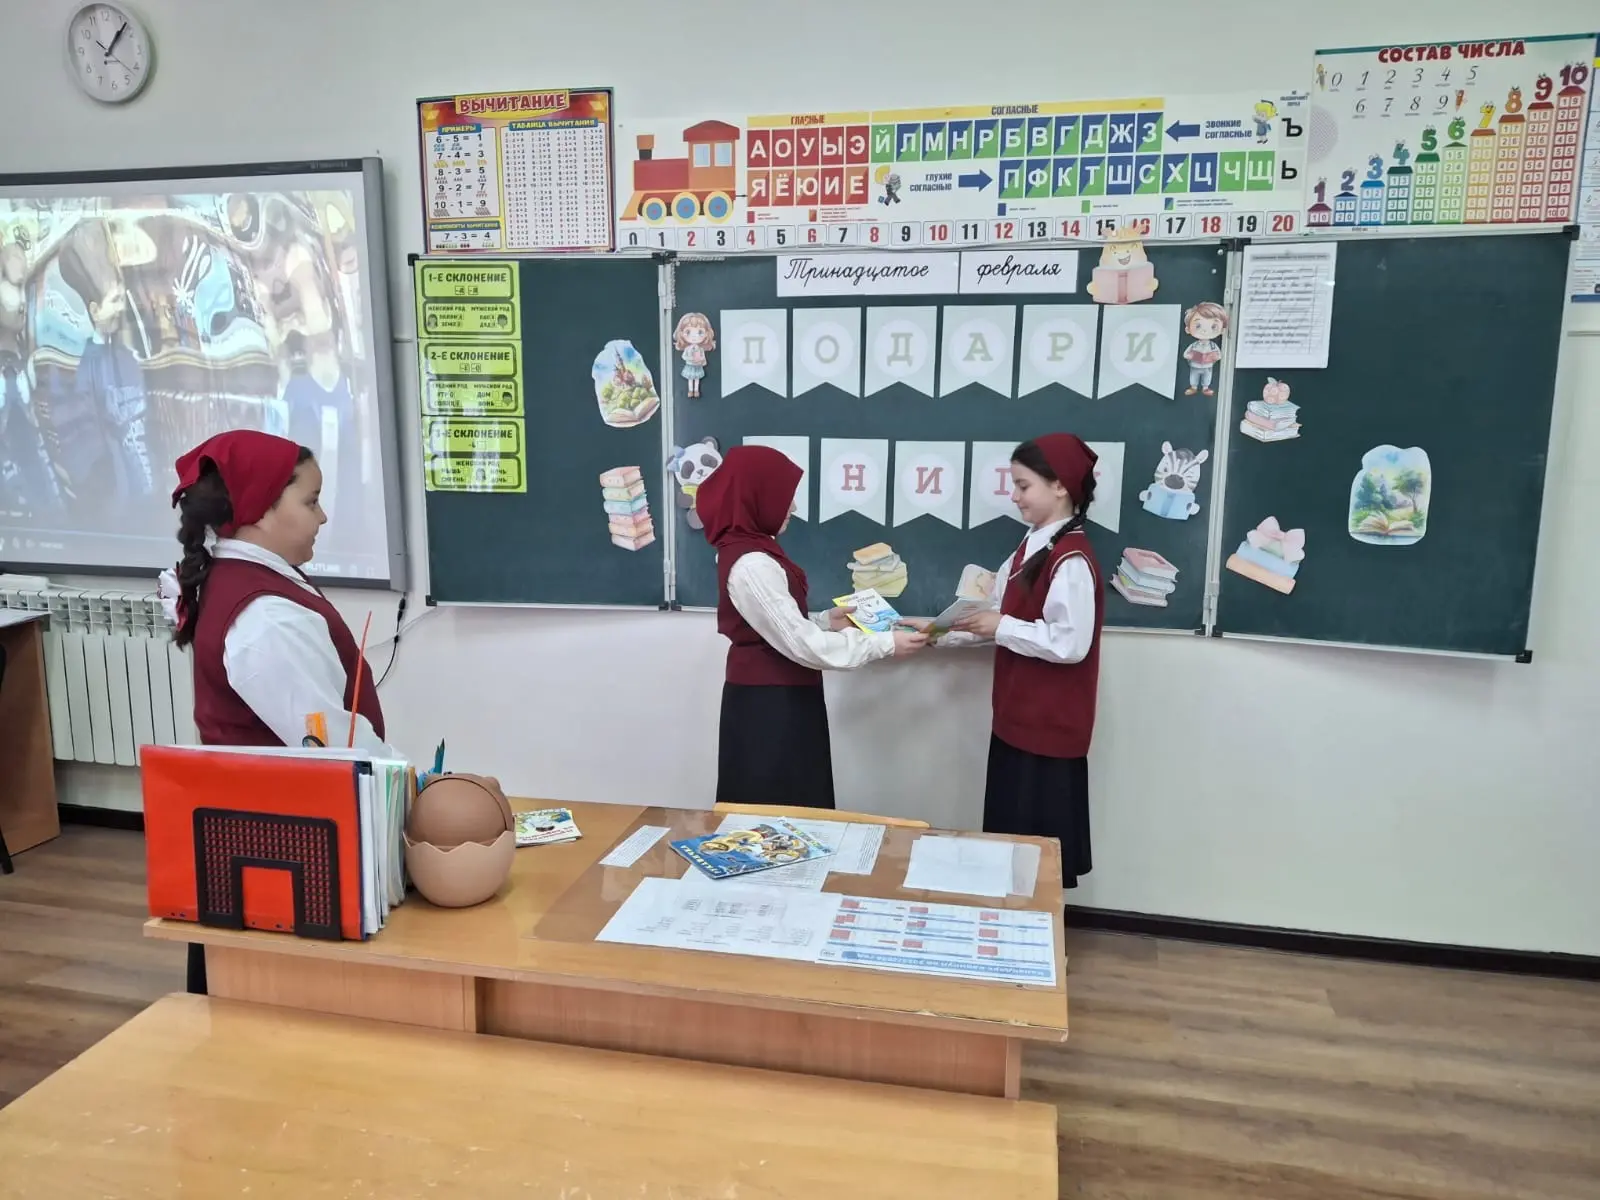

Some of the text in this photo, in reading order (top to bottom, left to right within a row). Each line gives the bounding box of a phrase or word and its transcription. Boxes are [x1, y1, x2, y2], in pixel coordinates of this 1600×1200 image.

[89, 16, 97, 26] 11
[102, 11, 110, 22] 12
[81, 29, 91, 40] 10
[78, 46, 85, 56] 9
[1378, 40, 1526, 63] СОСТАВ ЧИСЛА
[111, 80, 118, 90] 6
[124, 74, 132, 86] 5
[1331, 65, 1480, 87] 0 1 2 3 4 5
[1559, 64, 1588, 86] 10
[1534, 76, 1553, 101] 9
[460, 93, 566, 113] ВЫЧИТАНИЕ
[992, 104, 1039, 116] СОГЛАСНЫЕ
[1355, 95, 1449, 113] 6 7 8 9
[1504, 90, 1522, 114] 8
[791, 114, 824, 126] ГЛАСНЫЕ
[1478, 105, 1496, 128] 7
[1281, 118, 1303, 137] Ъ
[1448, 119, 1466, 140] 6
[750, 136, 865, 158] А О У Ы Э
[875, 123, 1157, 154] Й Л М Н Р Б В Г Д Ж З
[1420, 128, 1438, 151] 5
[1392, 143, 1410, 165] 4
[1004, 160, 1273, 189] П Ф К Т Ш С Х Ц Ч Щ
[1281, 160, 1298, 180] Ь
[1366, 157, 1384, 180] 3
[751, 174, 864, 198] Я Ё Ю И Е
[1314, 180, 1326, 202] 1
[1340, 170, 1356, 191] 2
[658, 232, 664, 246] 1
[687, 231, 696, 246] 2
[717, 230, 725, 246] 3
[746, 230, 755, 245] 4
[777, 229, 786, 245] 5
[808, 228, 816, 243] 6
[838, 228, 847, 243] 7
[870, 226, 879, 243] 8
[901, 226, 911, 242] 9
[929, 224, 948, 241] 10
[962, 223, 978, 240] 11
[994, 222, 1013, 239] 12
[1027, 221, 1046, 238] 13
[1061, 220, 1080, 237] 14
[1096, 219, 1116, 236] 15
[1166, 218, 1186, 234] 17
[1201, 217, 1221, 233] 18
[1237, 216, 1257, 232] 19
[1273, 215, 1294, 232] 20
[428, 273, 507, 282] 1-Е СКЛОНЕНИЕ
[784, 257, 1062, 288] Тринадцатое февраля
[431, 352, 510, 360] 2-Е СКЛОНЕНИЕ
[454, 429, 513, 438] СКЛОНЕНИЕ
